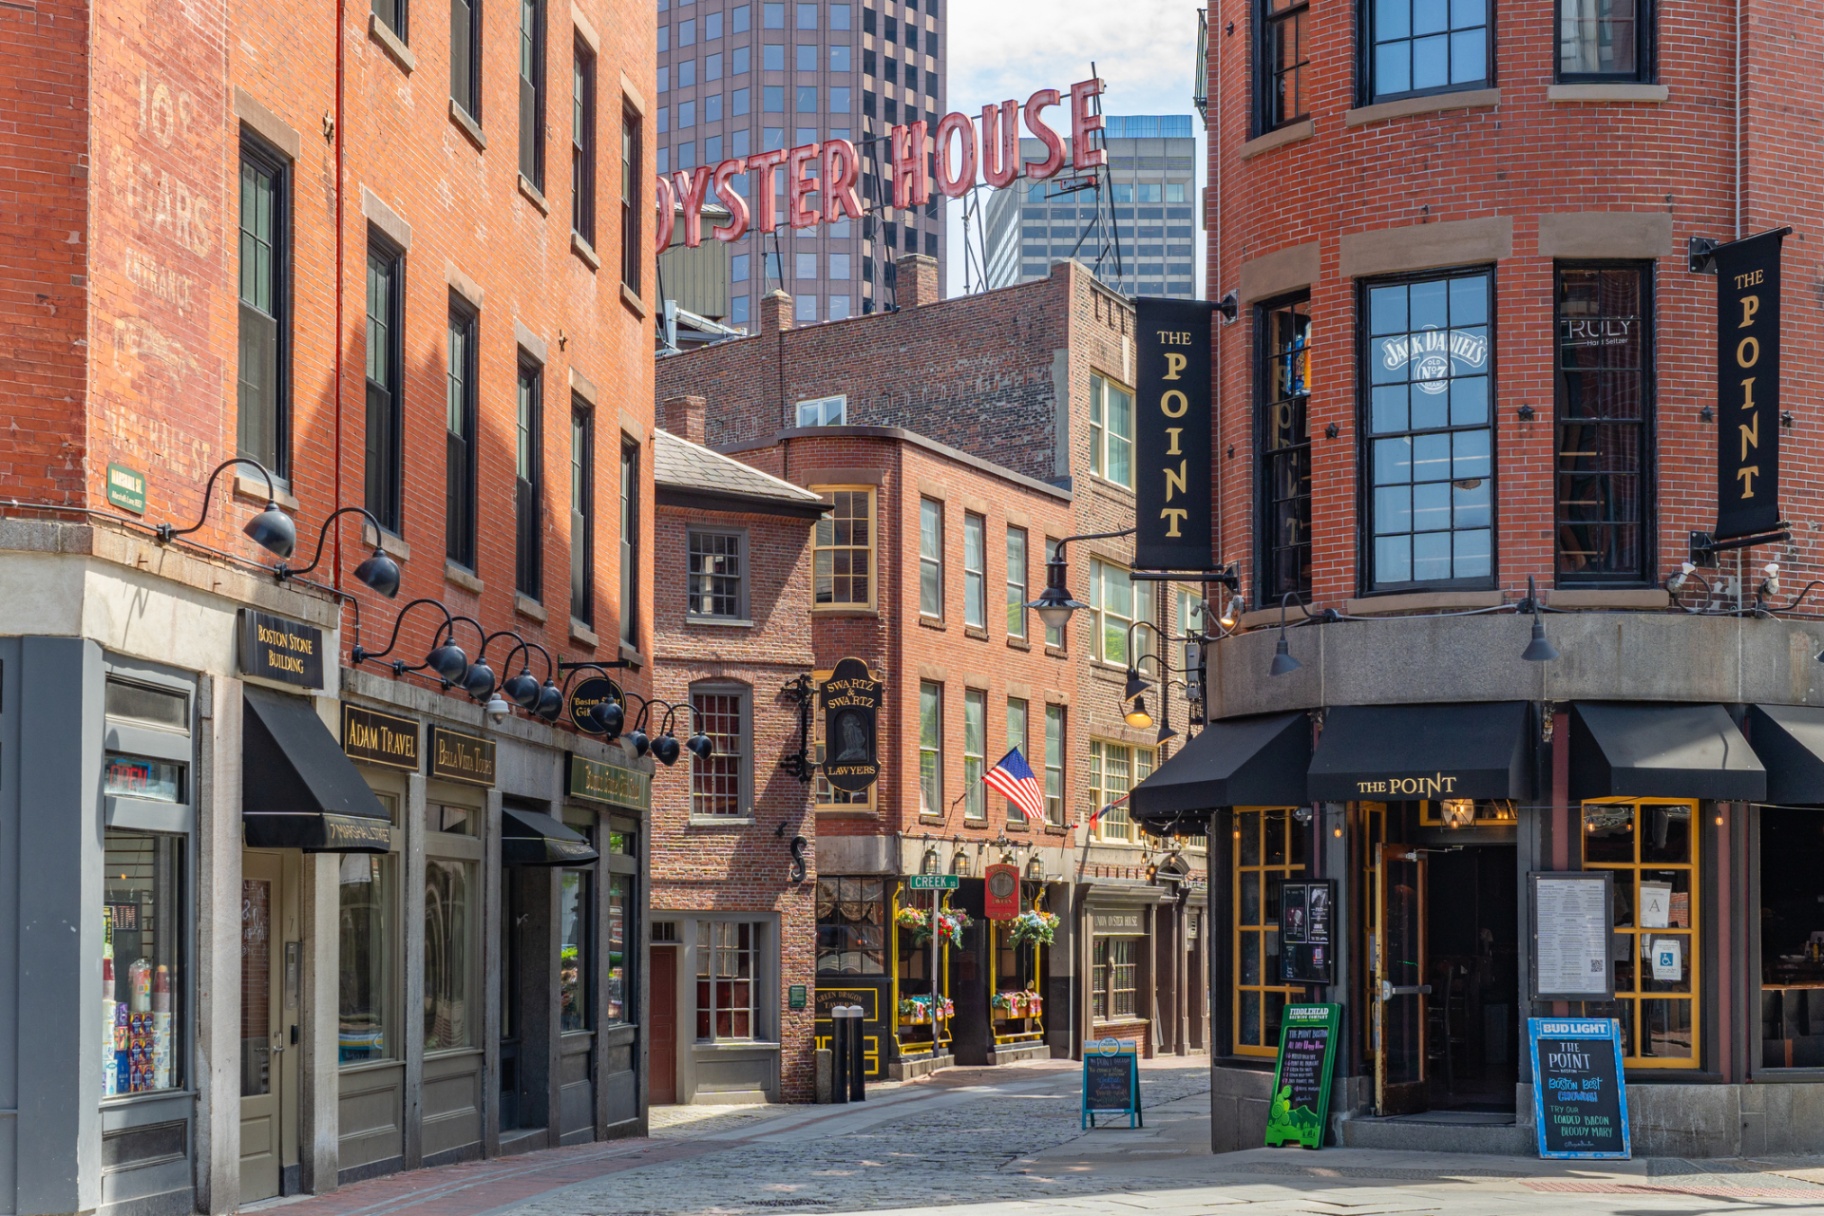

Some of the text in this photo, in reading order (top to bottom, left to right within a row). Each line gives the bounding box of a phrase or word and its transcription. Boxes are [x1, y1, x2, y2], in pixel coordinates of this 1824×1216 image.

[891, 78, 1108, 210] HOUSE
[1734, 269, 1764, 290] THE
[1157, 330, 1192, 345] THE
[1385, 331, 1486, 367] JACK DANIEL'S
[1736, 294, 1760, 500] POINT
[1160, 352, 1189, 538] POINT
[258, 624, 313, 655] BOSTON STONE
[268, 649, 304, 674] BUILDING
[827, 678, 875, 693] SWARTZ
[847, 688, 855, 697] &
[828, 695, 875, 709] SWARTZ
[349, 718, 416, 758] ADAM TRAVEL
[474, 747, 492, 775] TOURS
[110, 765, 148, 791] OPEN
[828, 765, 876, 776] LAWYERS
[1357, 772, 1457, 799] THE POINT
[330, 823, 336, 839] 7
[915, 876, 947, 888] CREEK
[1649, 899, 1661, 912] A
[816, 991, 837, 1003] GREEN
[838, 991, 863, 1003] DRAGON
[1290, 1007, 1329, 1016] FIDDLEHEAD
[1543, 1023, 1607, 1034] BUD LIGHT
[1560, 1042, 1580, 1053] THE
[1548, 1053, 1590, 1070] POINT
[1550, 1105, 1579, 1113] TRY OUR
[1554, 1115, 1610, 1125] LOADED BACON
[1561, 1126, 1613, 1138] BLOODY MARY
